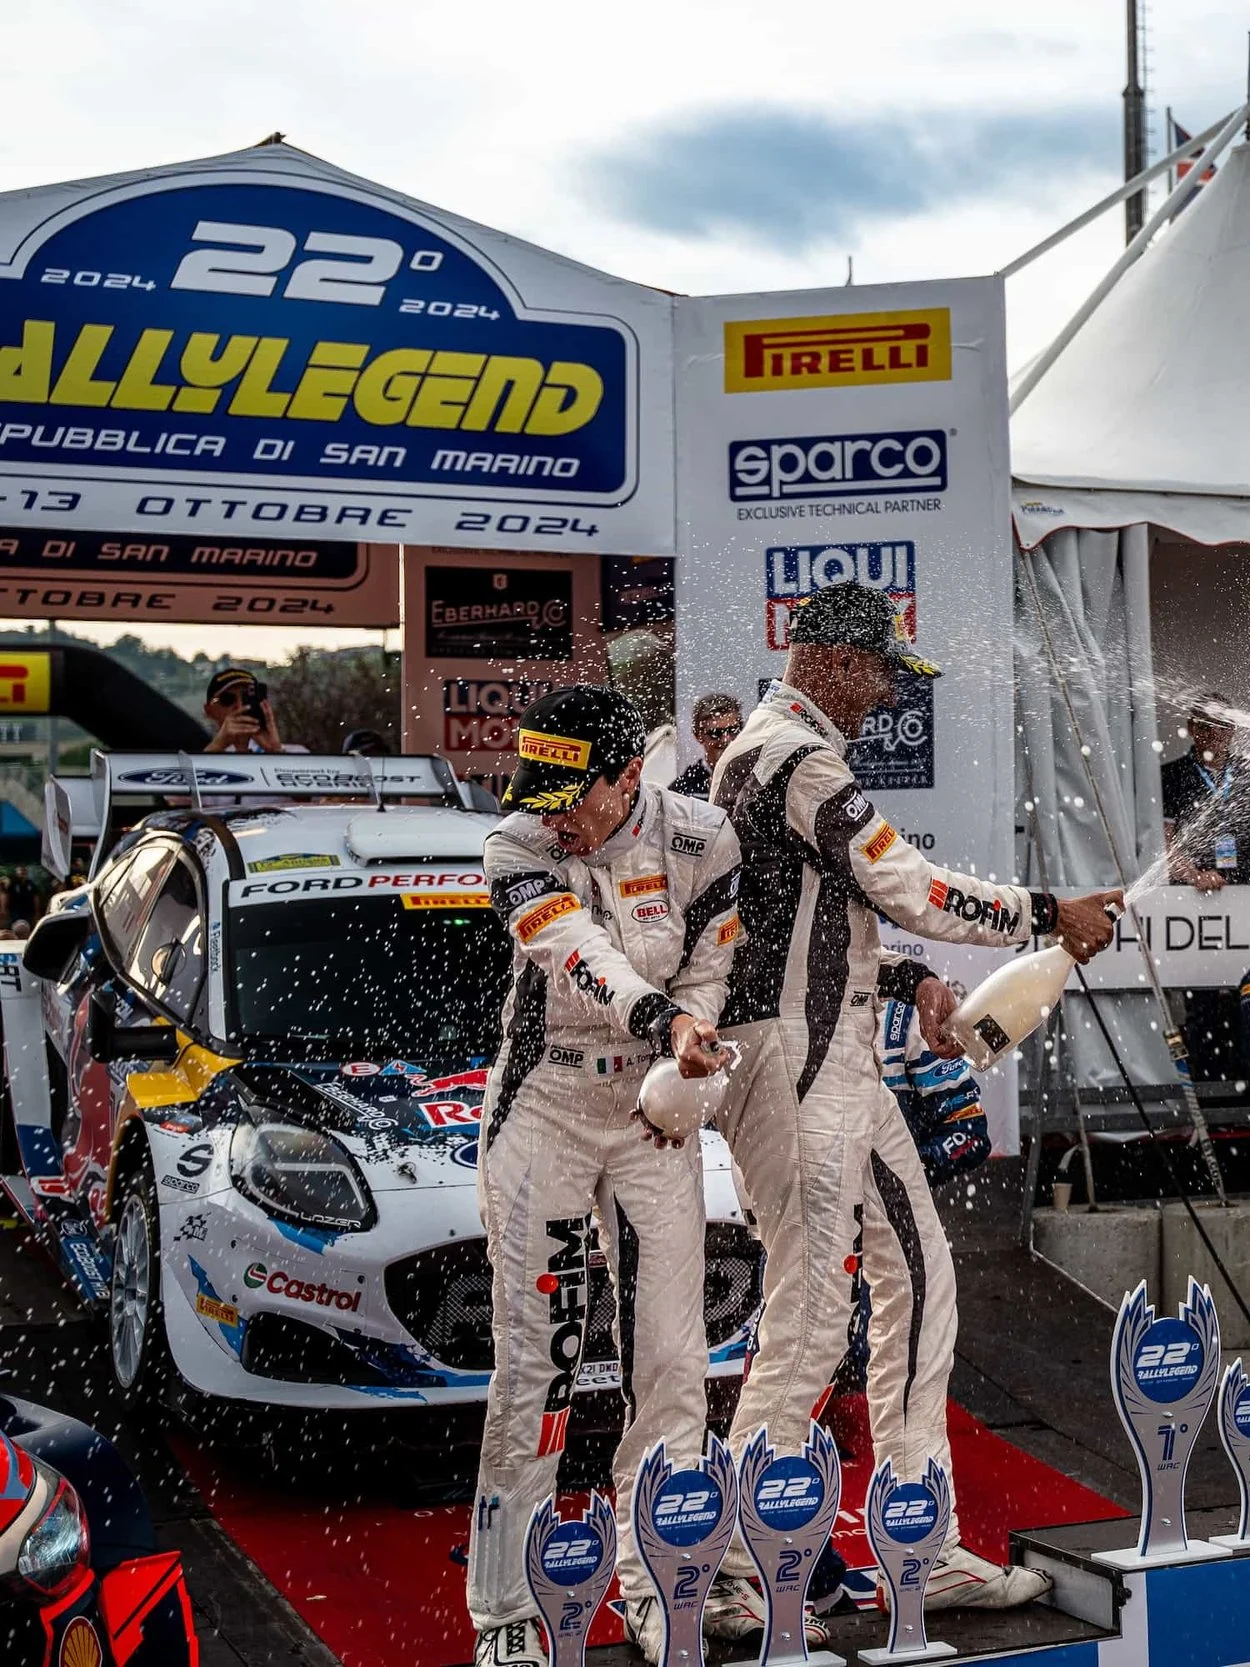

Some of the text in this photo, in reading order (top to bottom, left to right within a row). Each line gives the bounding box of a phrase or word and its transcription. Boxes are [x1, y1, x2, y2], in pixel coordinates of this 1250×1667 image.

[41, 268, 156, 291] 2024
[399, 298, 500, 320] 2024
[743, 322, 931, 379] PIRELLI
[0, 422, 581, 478] PUBBLICA DI SAN MARINO
[735, 436, 941, 496] sparco
[136, 495, 413, 528] OTTOBRE
[455, 511, 600, 537] 2024
[737, 498, 942, 521] EXCLUSIVE TECHNICAL PARTNER
[42, 541, 77, 558] DI
[98, 542, 170, 563] SAN
[191, 545, 319, 568] MARINO
[771, 545, 909, 595] LIQUI
[211, 595, 335, 615] 2024
[431, 600, 541, 625] EBERHARD
[450, 719, 520, 749] MO
[670, 832, 708, 856] OMP
[241, 873, 489, 898] FORD PERFO
[507, 876, 546, 906] OMP
[514, 896, 577, 942] PIRELLI
[635, 904, 668, 918] BELL
[1165, 915, 1250, 951] DEL
[889, 1002, 906, 1041] sparco
[548, 1045, 585, 1068] OMP
[163, 1177, 198, 1193] sparco
[266, 1271, 363, 1313] Castrol
[199, 1299, 236, 1324] PIRELLI
[1137, 1364, 1199, 1380] RALLYLEGEND
[758, 1497, 819, 1511] RALLYLEGEND
[656, 1510, 717, 1526] RALLYLEGEND
